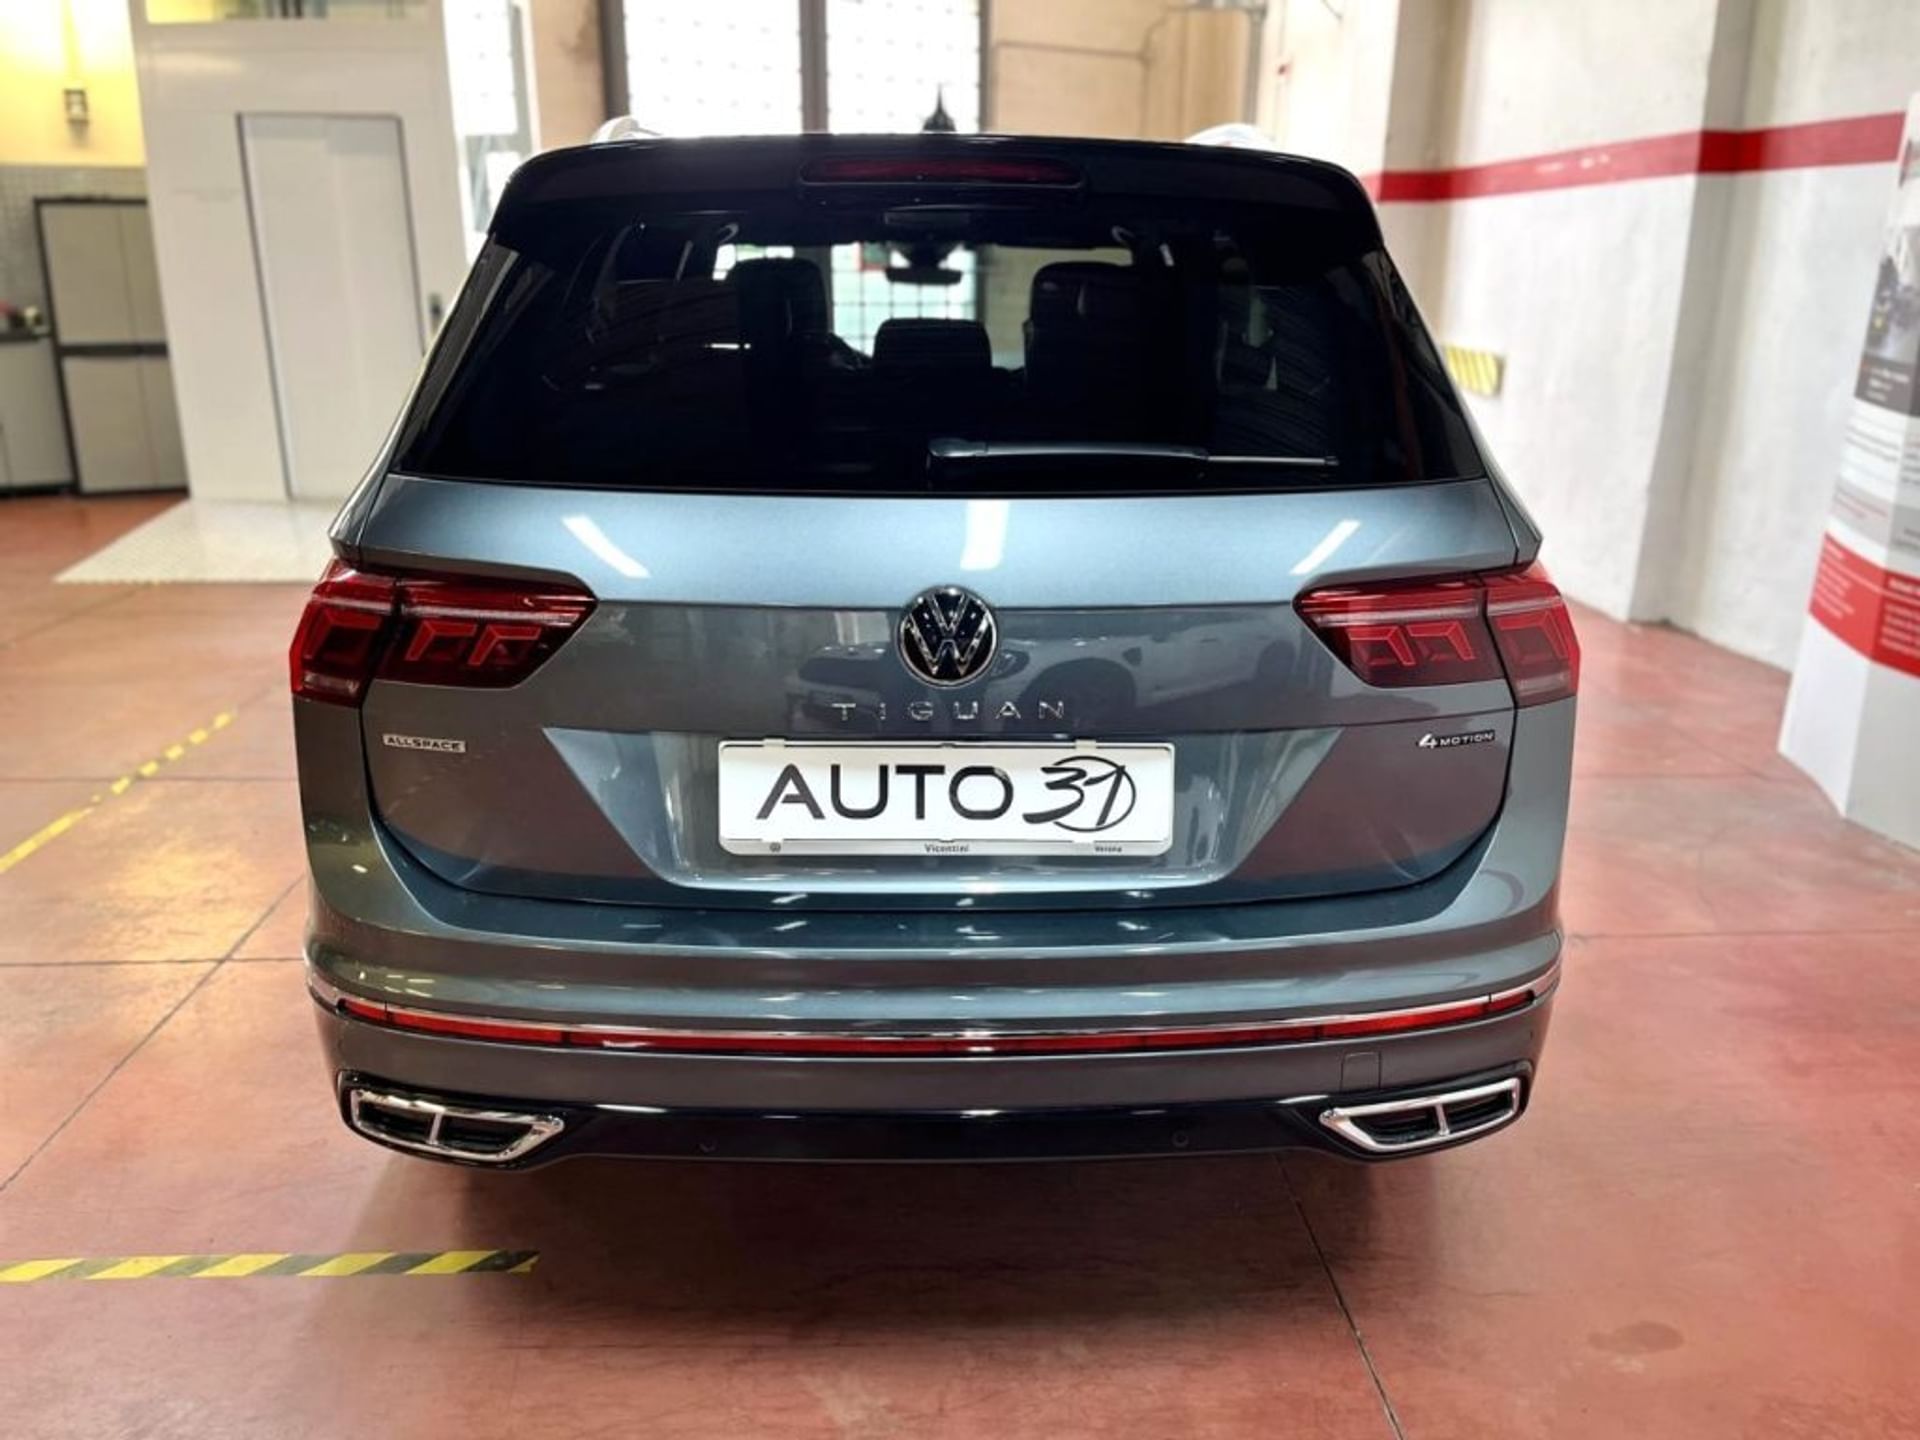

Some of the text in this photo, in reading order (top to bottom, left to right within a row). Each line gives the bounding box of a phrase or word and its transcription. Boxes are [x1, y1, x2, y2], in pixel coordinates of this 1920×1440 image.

[831, 702, 1066, 720] TIGUAN
[386, 736, 462, 752] ALLSPACE
[1418, 732, 1494, 749] 4MOTION
[756, 764, 1014, 820] AUTO
